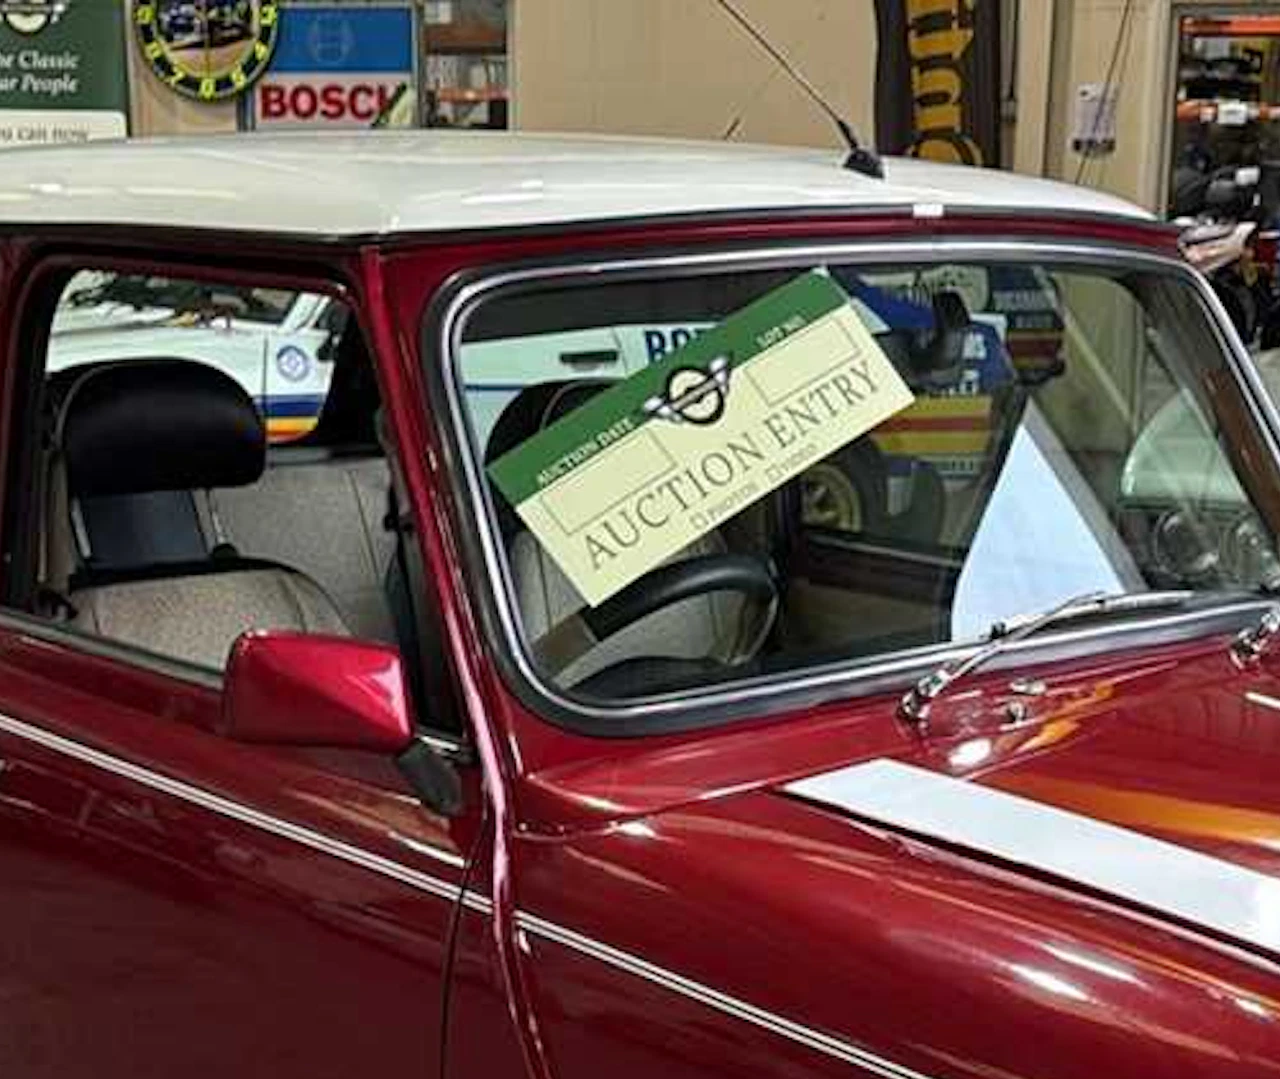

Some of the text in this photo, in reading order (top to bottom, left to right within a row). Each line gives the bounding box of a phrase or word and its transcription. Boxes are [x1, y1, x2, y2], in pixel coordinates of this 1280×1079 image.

[19, 51, 79, 69] Classic
[22, 73, 78, 95] People
[17, 127, 48, 141] can
[536, 439, 598, 486] AUCTION
[583, 432, 766, 570] AUCTION
[762, 358, 880, 449] ENTRY
